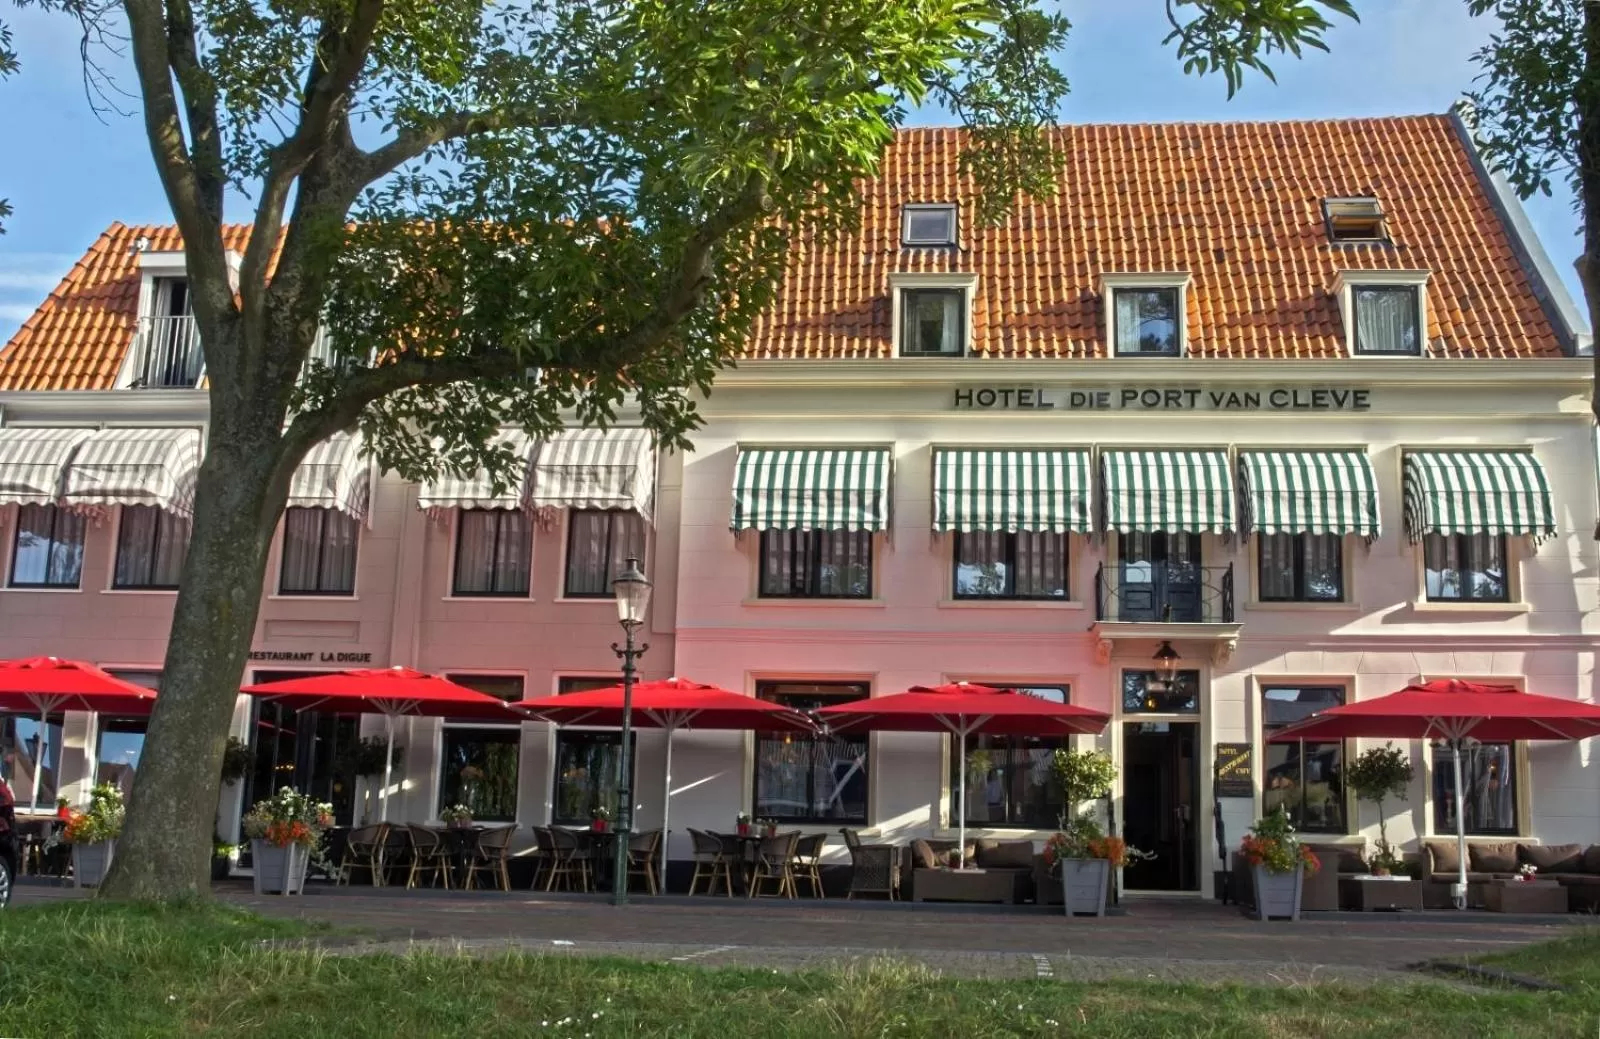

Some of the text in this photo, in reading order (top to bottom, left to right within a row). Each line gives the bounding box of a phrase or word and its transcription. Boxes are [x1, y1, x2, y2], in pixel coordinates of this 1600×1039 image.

[955, 388, 1371, 408] HOTEL DIE PORT VAN CLEVE
[247, 651, 372, 662] RESTAURANT LA DIGUE
